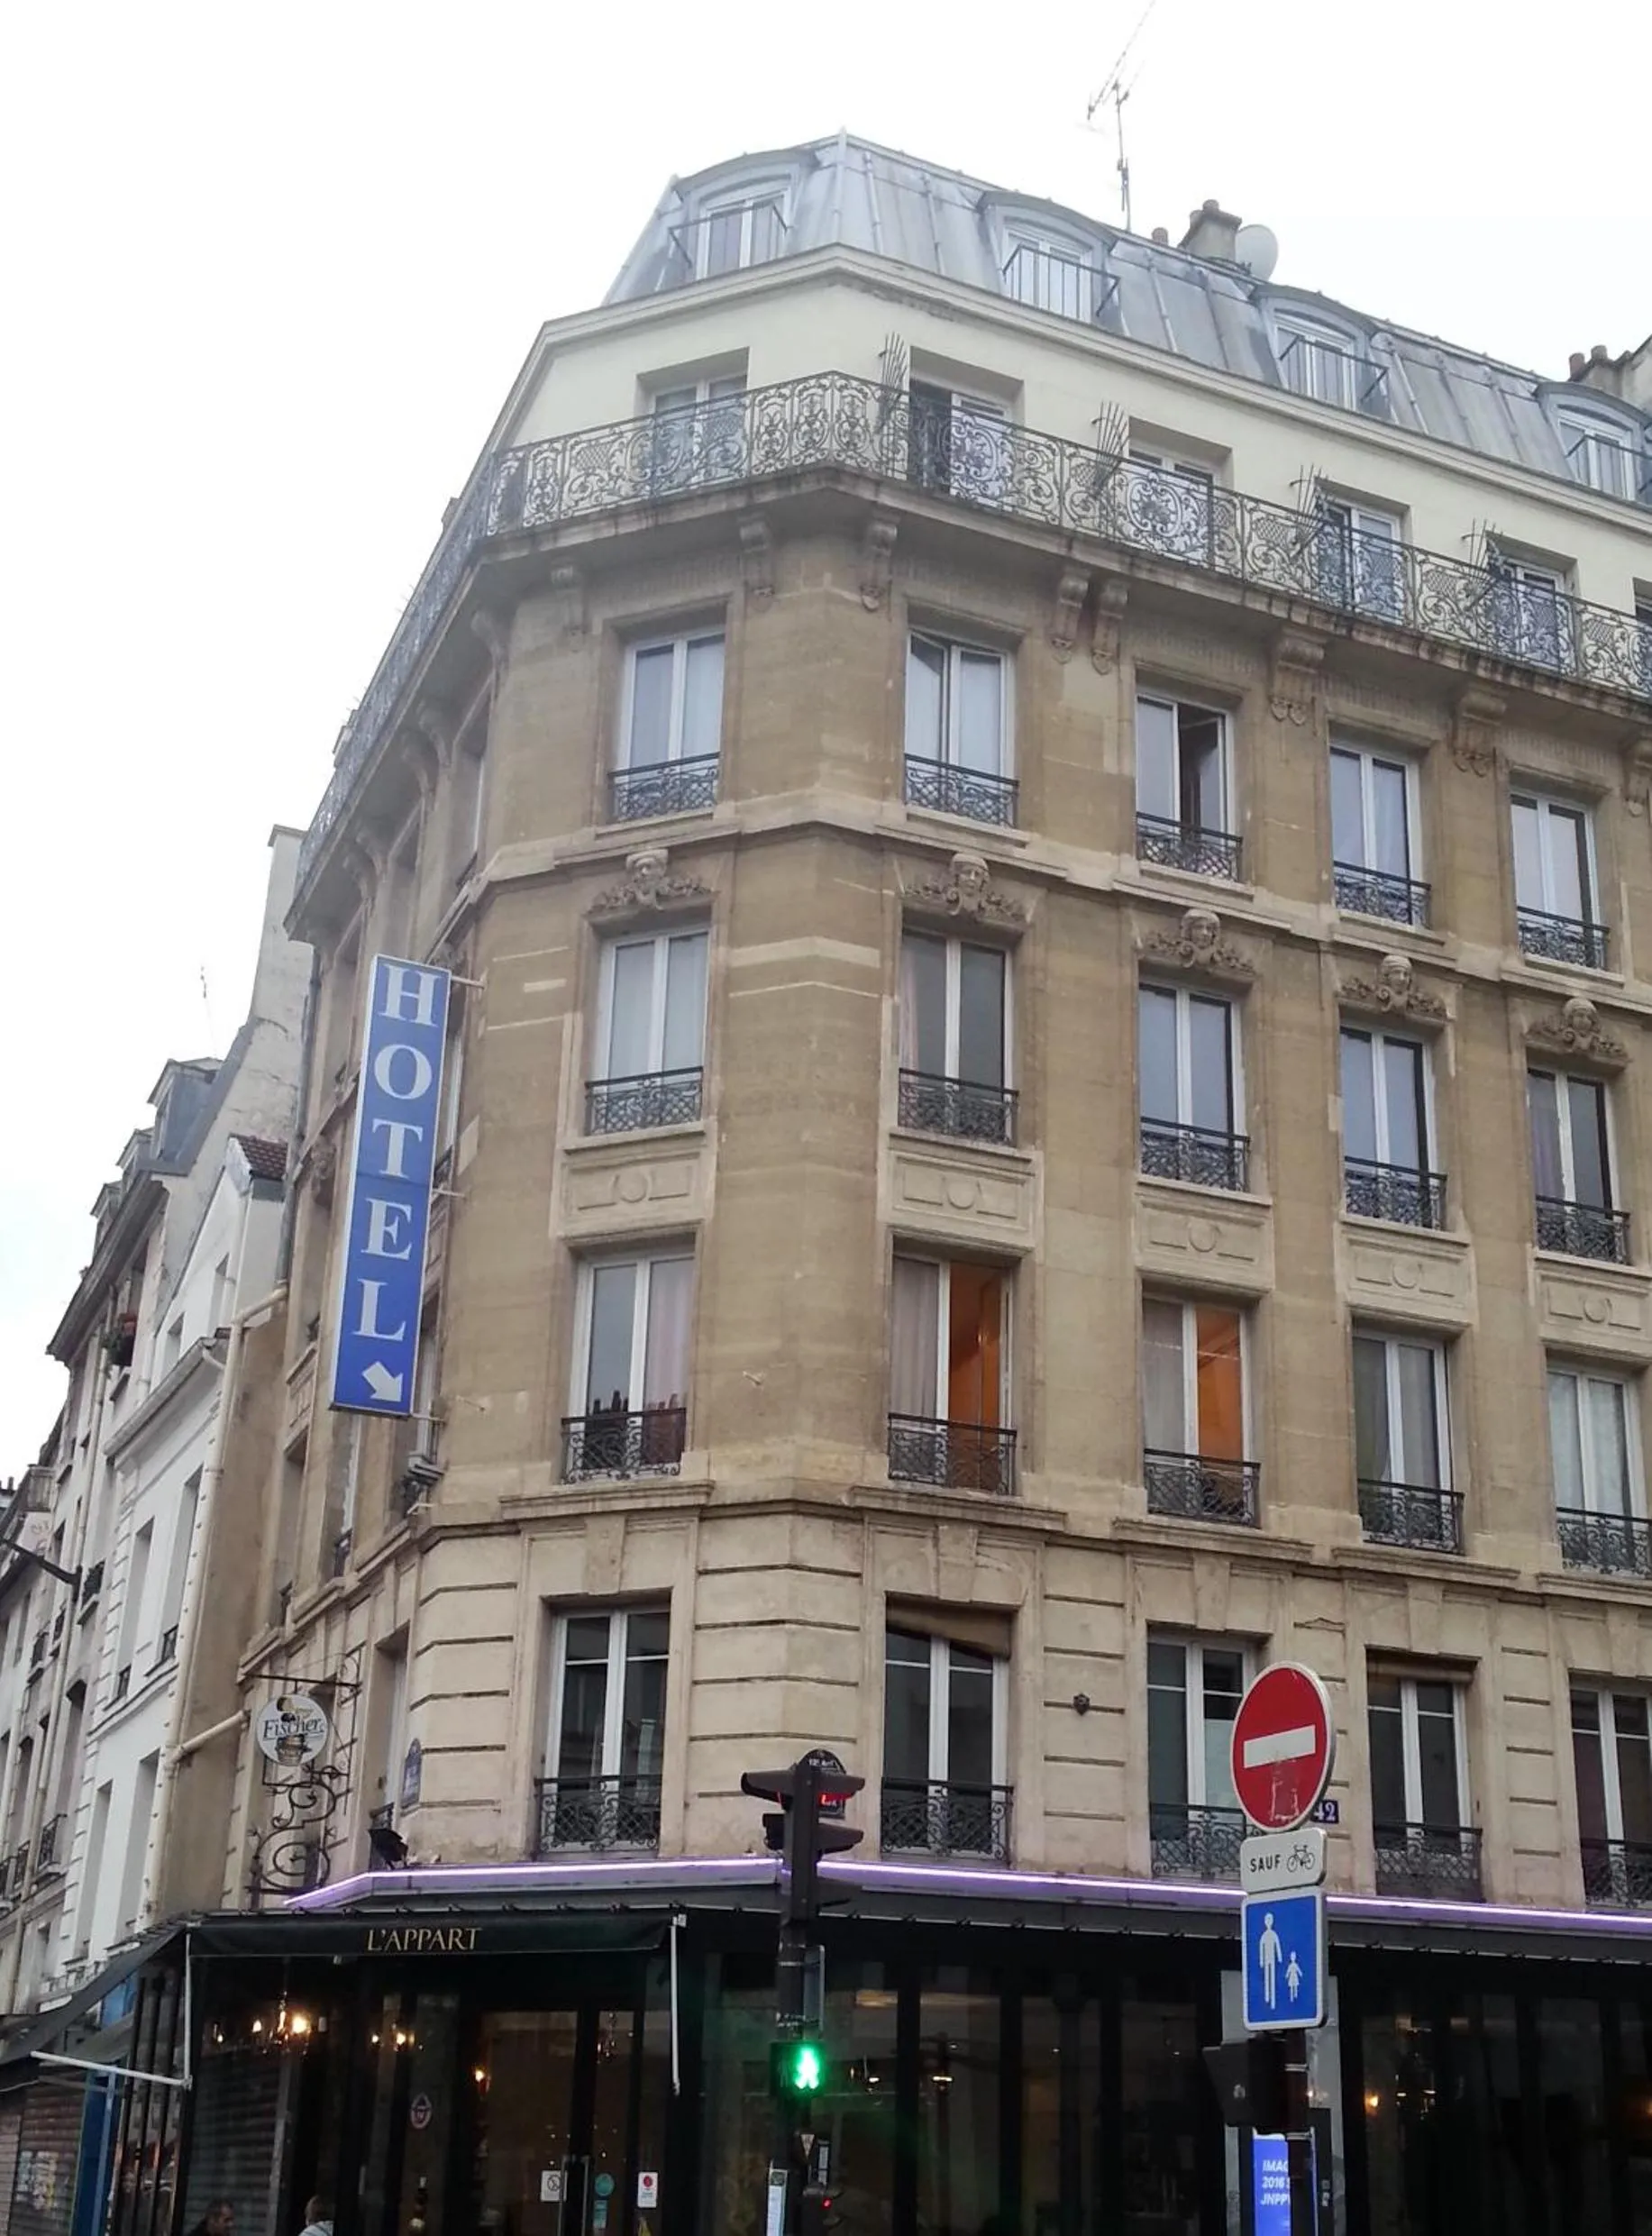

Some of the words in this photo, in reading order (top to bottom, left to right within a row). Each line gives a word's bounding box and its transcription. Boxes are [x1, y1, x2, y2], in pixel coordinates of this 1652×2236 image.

[353, 963, 443, 1342] HOTEL
[262, 1714, 322, 1740] Fischer
[1313, 1801, 1337, 1821] 42
[1250, 1854, 1281, 1873] SAUF
[368, 1928, 483, 1951] L'APPART
